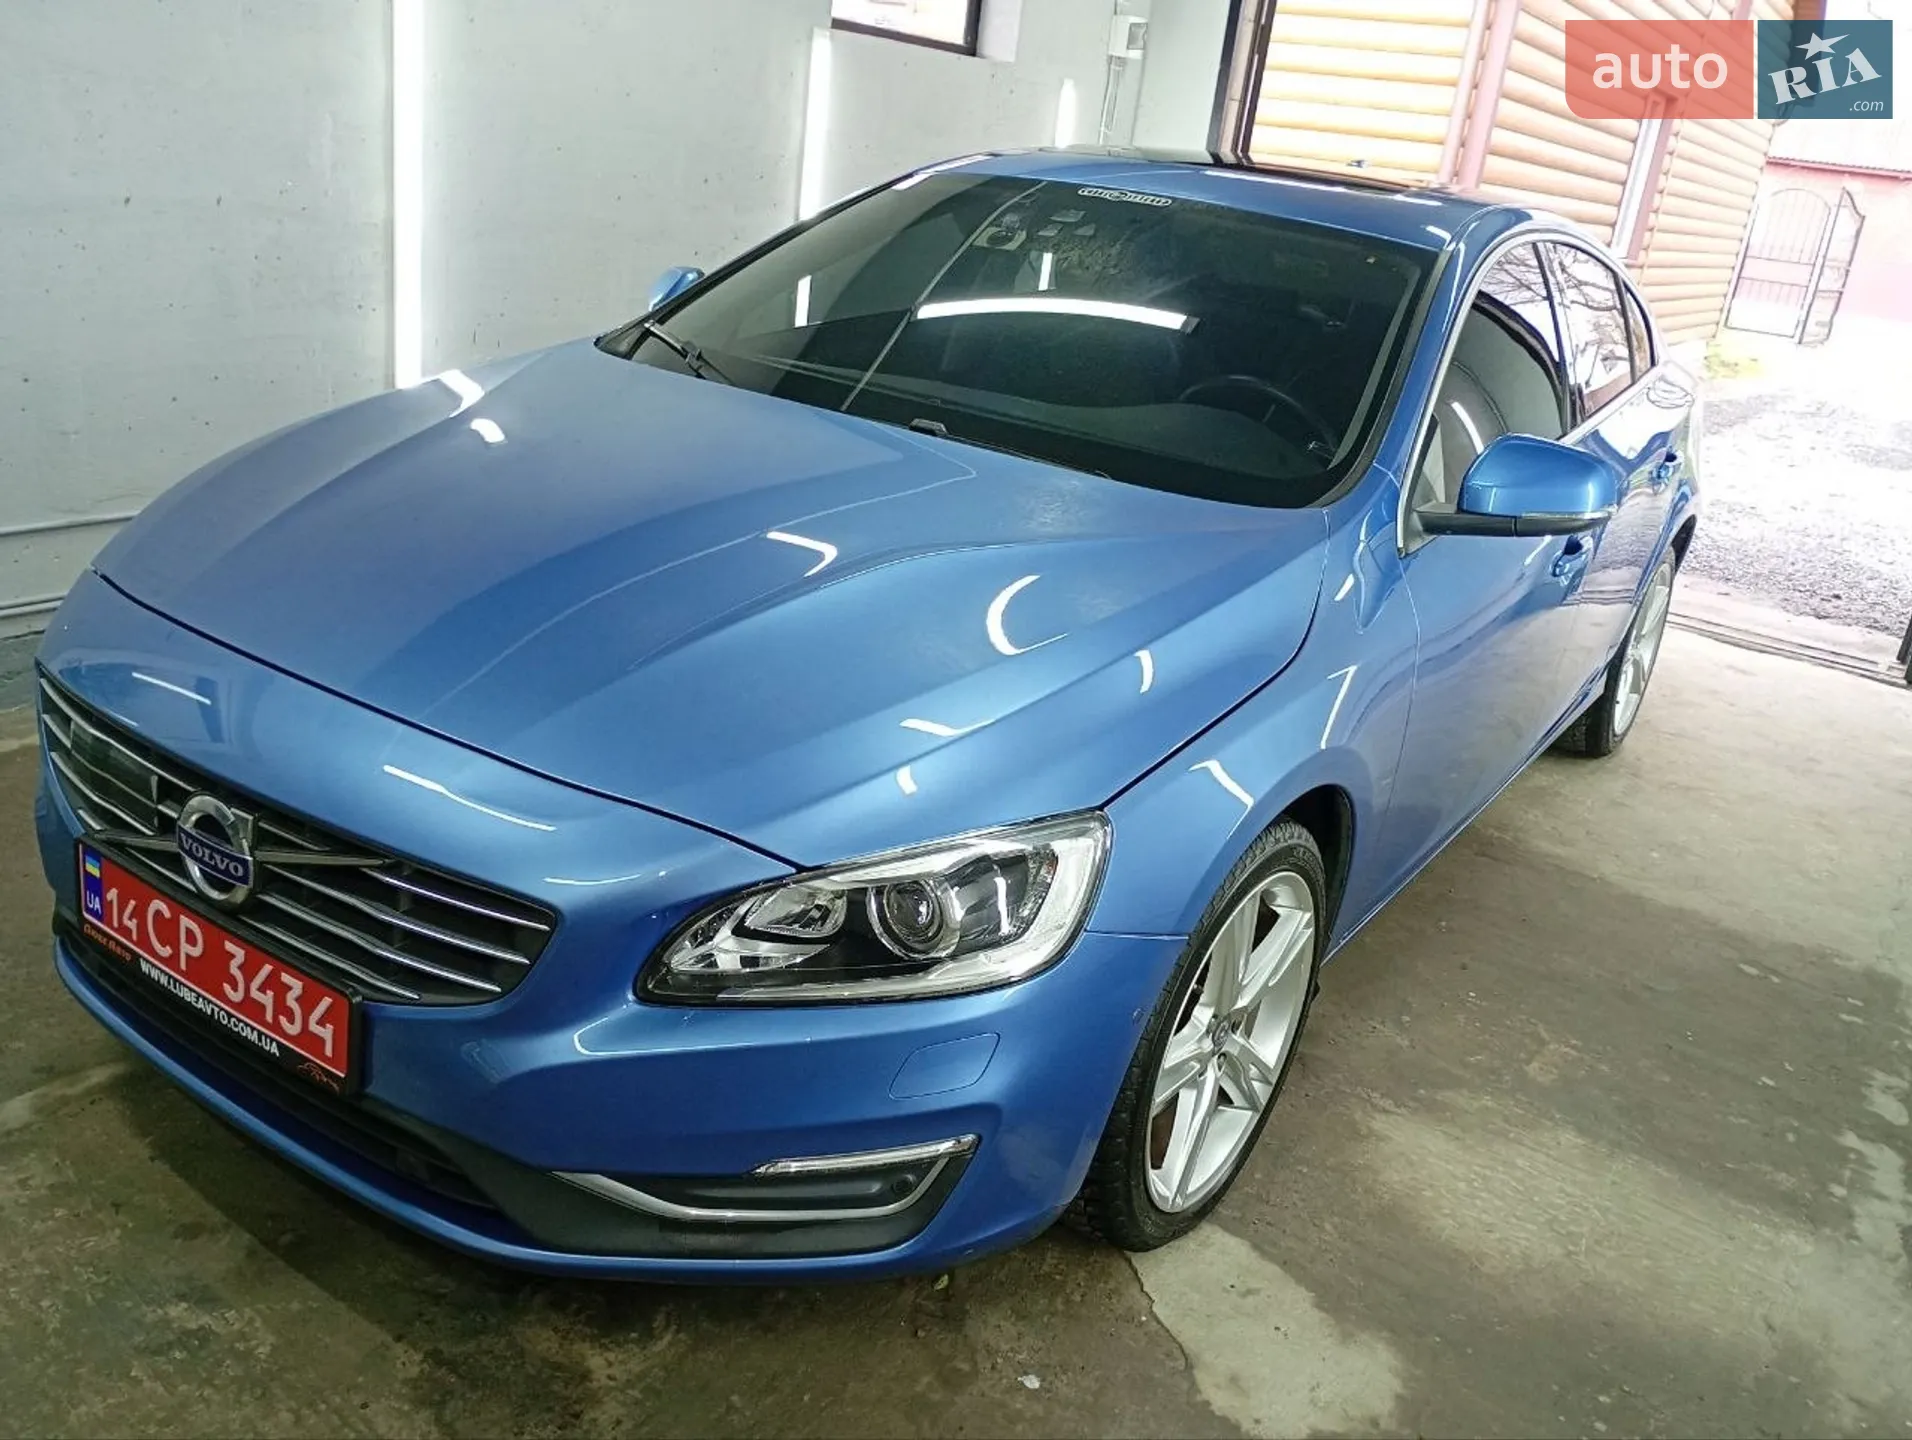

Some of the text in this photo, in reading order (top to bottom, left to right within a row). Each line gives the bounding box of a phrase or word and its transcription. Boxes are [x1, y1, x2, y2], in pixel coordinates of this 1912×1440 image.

[180, 832, 244, 877] VOLVO
[86, 891, 102, 914] UA
[140, 957, 280, 1057] WWW.LUBEAVTO.COM.UA
[222, 939, 335, 1058] 3434
